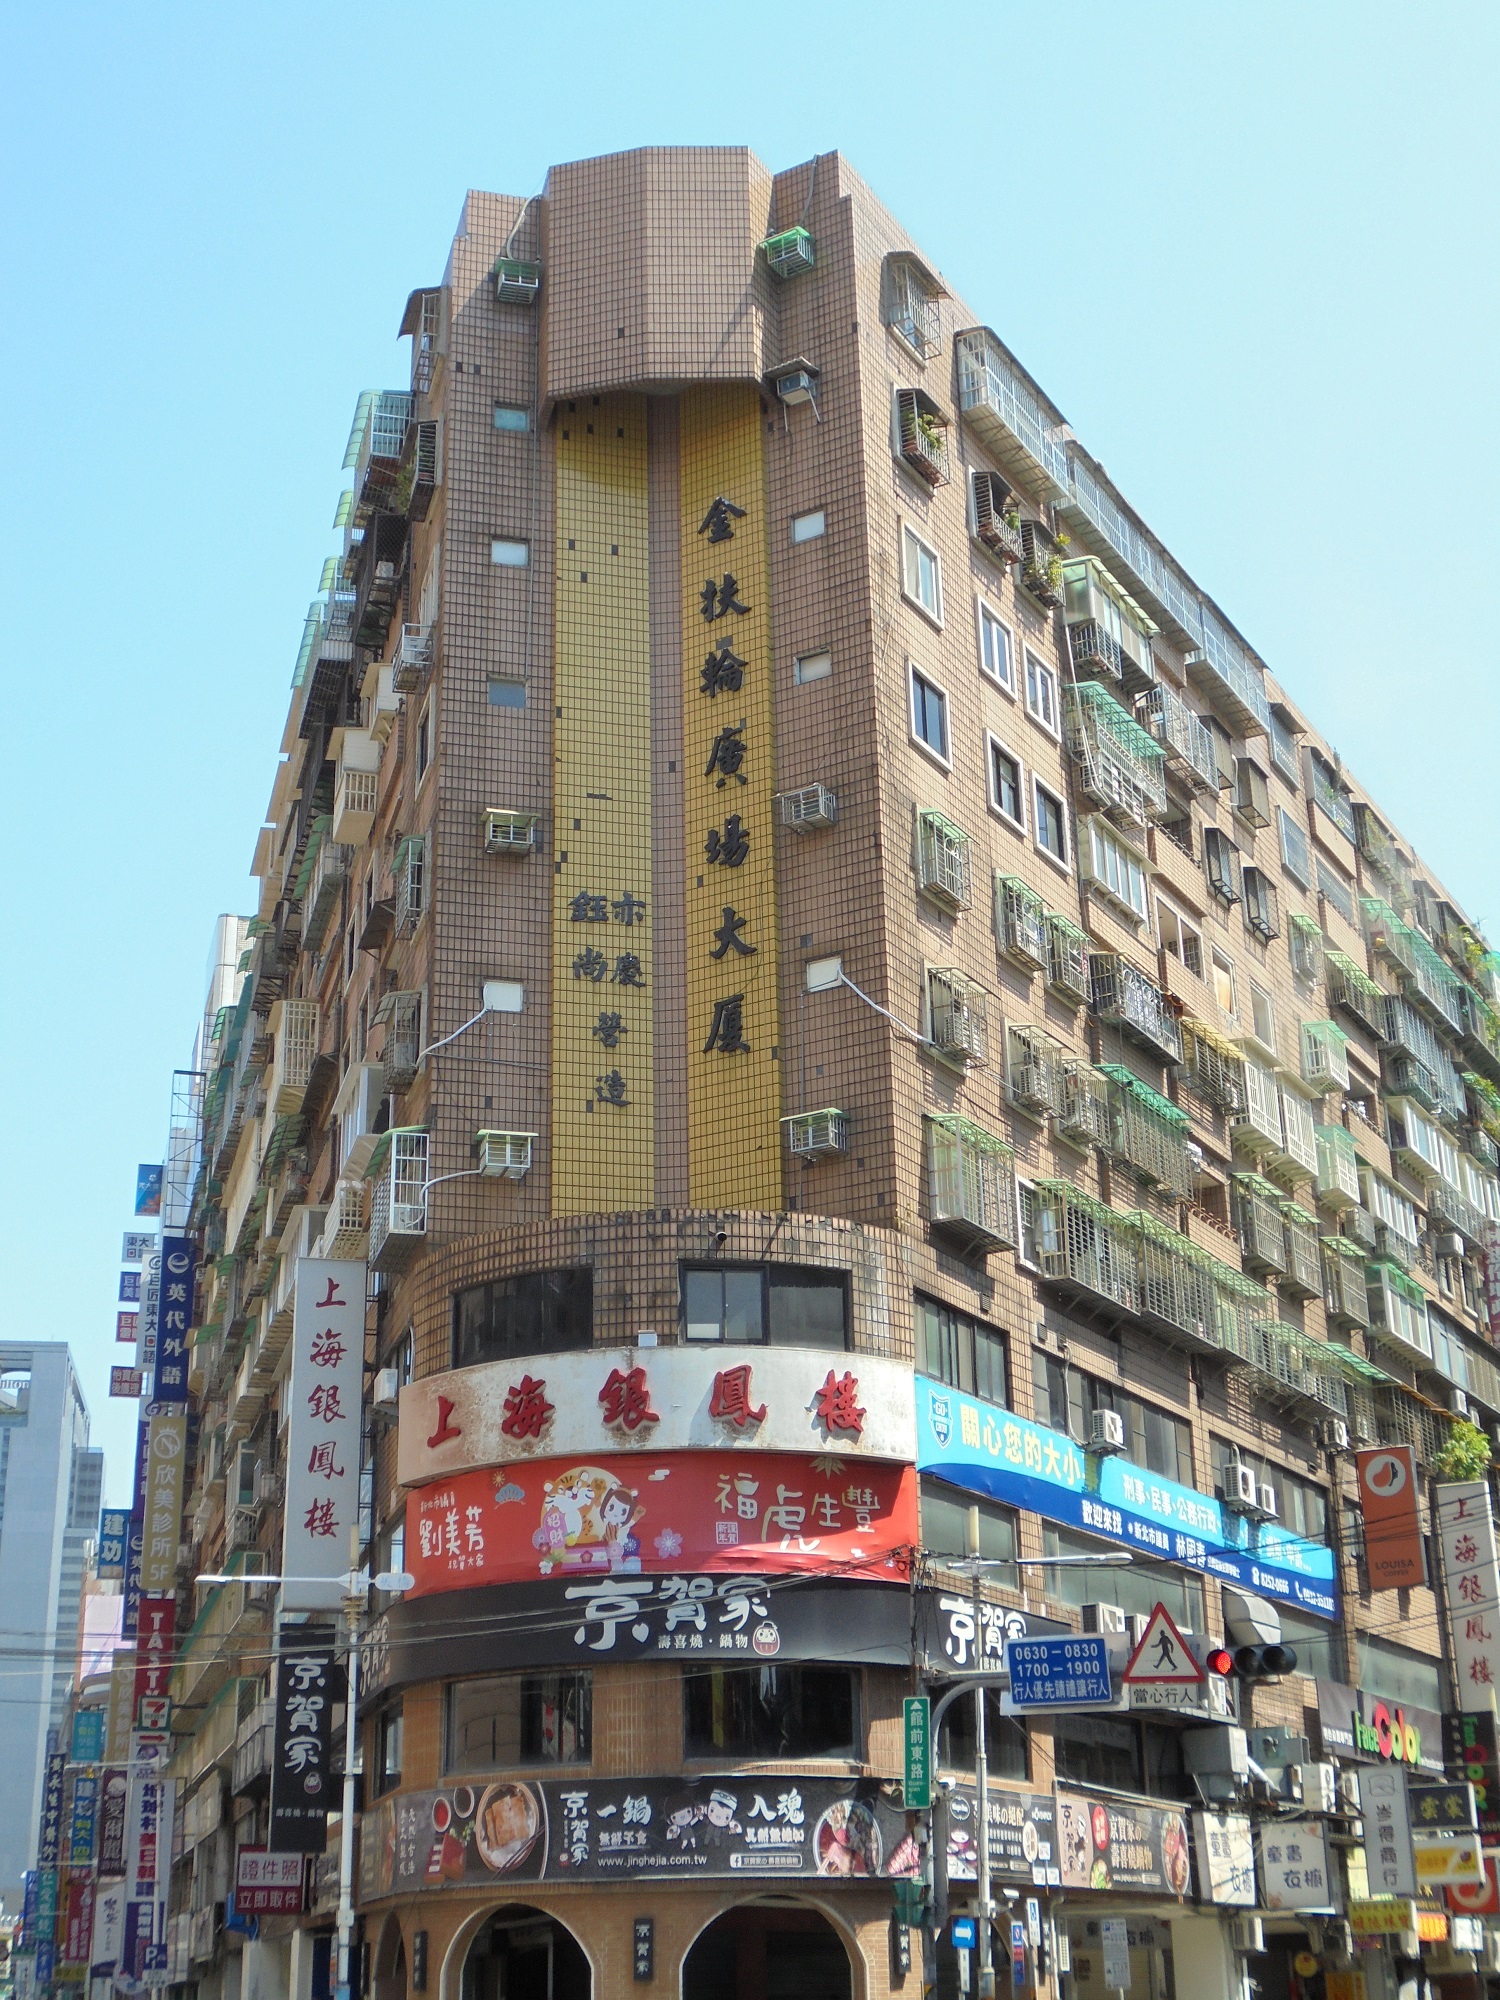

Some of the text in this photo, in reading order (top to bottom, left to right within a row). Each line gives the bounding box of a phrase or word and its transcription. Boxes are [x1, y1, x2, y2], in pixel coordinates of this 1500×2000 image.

[698, 496, 758, 1055] 金扶輪廣場大廈
[592, 1011, 632, 1107] 營造
[161, 1283, 188, 1385] 英代外語
[0, 1380, 29, 1389] ilton
[303, 1278, 347, 1539] 上海銀鳳樓
[427, 1363, 868, 1449] 上海銀鳳樓
[101, 1513, 124, 1562] 建功
[419, 1506, 485, 1558] 劉美芳
[547, 1514, 565, 1545] 招財
[1375, 1558, 1415, 1573] LOUISA
[1452, 1497, 1496, 1685] 上海銀鳳樓
[565, 1576, 771, 1650] 京賀家
[147, 1612, 164, 1696] TAST
[283, 1656, 330, 1774] 京賀家
[1013, 1678, 1109, 1701] 行人優先請禮讓行人
[1133, 1686, 1194, 1705] 當心行人
[910, 1711, 925, 1779] 館前東路
[560, 1791, 590, 1867] 京賀家
[596, 1795, 652, 1825] 一鍋
[747, 1787, 805, 1825] 入魂
[241, 1859, 300, 1881] 證件照
[597, 1853, 708, 1869] www.jinghejia.com.tw
[237, 1890, 299, 1909] 立即取件
